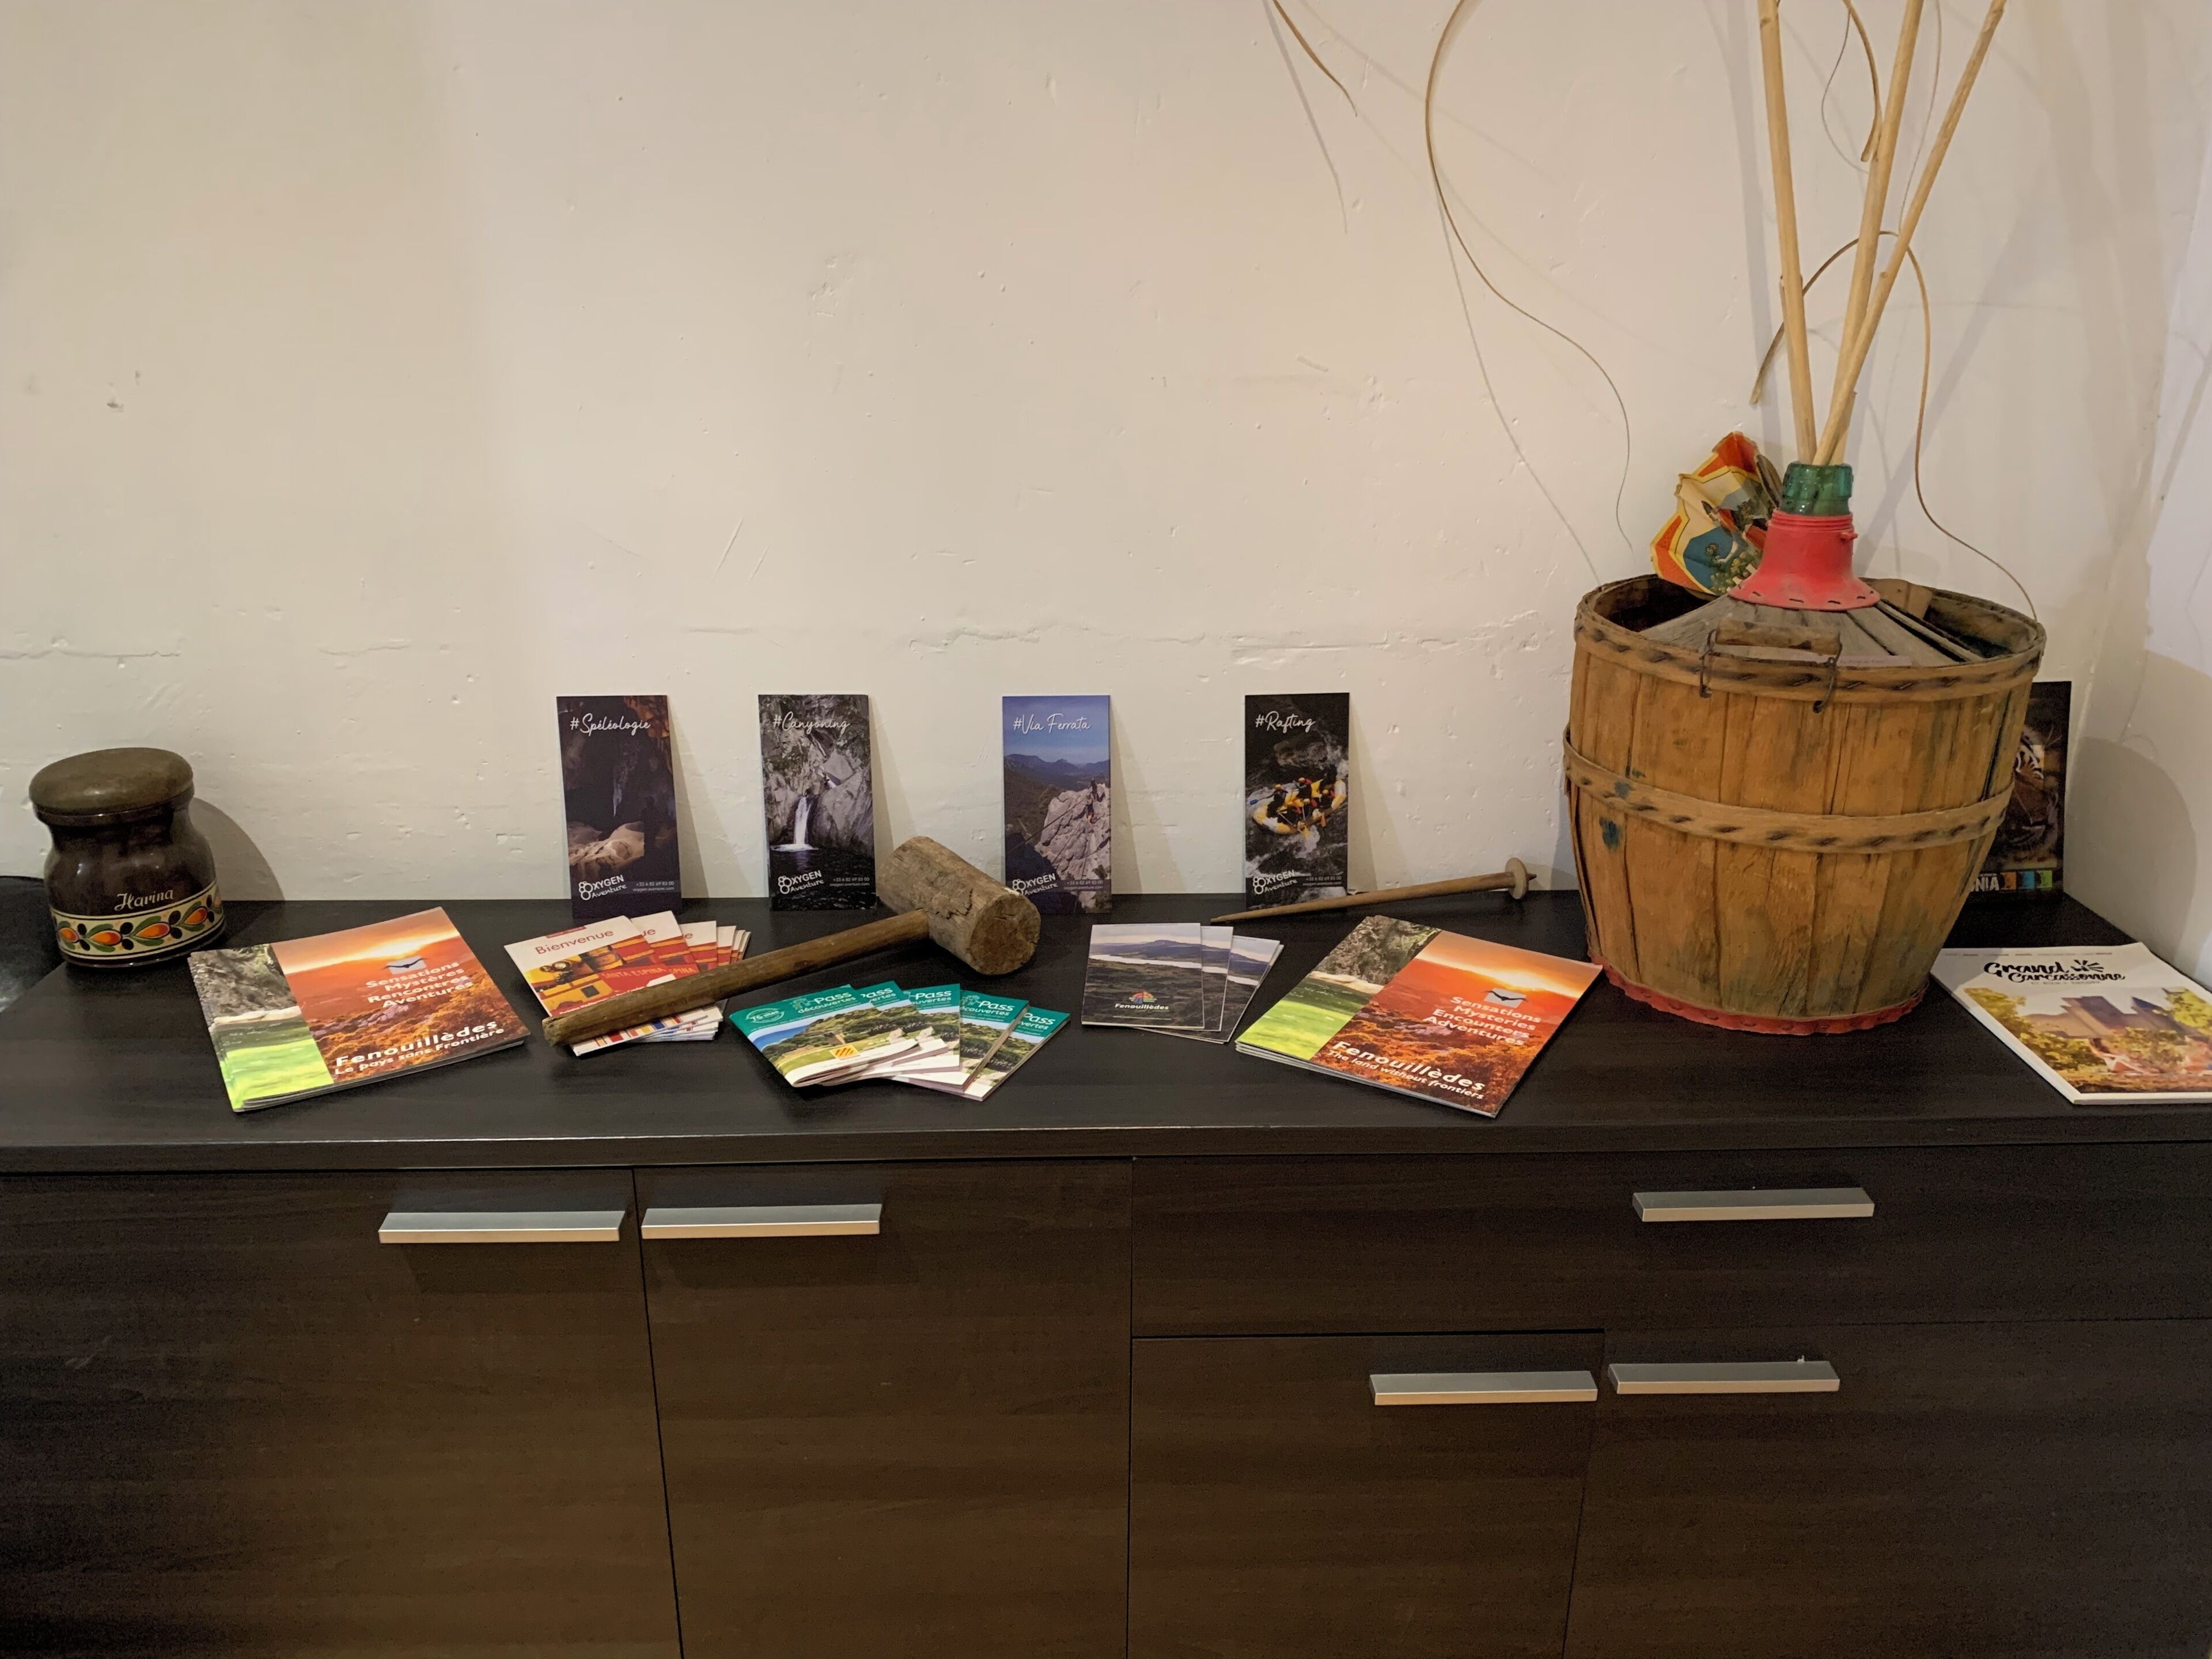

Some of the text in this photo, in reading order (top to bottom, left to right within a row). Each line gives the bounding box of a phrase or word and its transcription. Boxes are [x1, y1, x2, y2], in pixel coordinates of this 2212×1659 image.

[570, 713, 651, 737] #Spéléologie
[772, 711, 851, 734] #Canyoning
[1013, 713, 1093, 734] #Via Ferrata
[1255, 710, 1316, 733] #Rafting
[592, 884, 627, 899] Aventure
[790, 879, 824, 892] Aventure
[1024, 882, 1059, 896] Aventure
[1264, 879, 1297, 892] Aventure
[1971, 876, 1999, 892] NIA
[114, 889, 174, 911] Harina
[535, 930, 615, 955] Bienvenue
[366, 961, 460, 988] Sensations
[384, 968, 464, 991] Mystères
[631, 967, 666, 976] ESPINA
[1983, 961, 2070, 978] Grand
[2008, 972, 2126, 983] Carcassonne
[367, 975, 469, 1003] Rencontres
[382, 982, 474, 1008] Aventures
[814, 991, 853, 1004] Pass
[915, 990, 952, 1000] Pass
[798, 996, 857, 1014] découvertes
[978, 1001, 1015, 1012] Pass
[1450, 997, 1541, 1023] Sensations
[1432, 1009, 1530, 1039] Encounters
[1453, 1005, 1536, 1031] Mysteries
[1422, 1016, 1525, 1046] Adventures
[334, 1028, 505, 1075] Le pays sans Frontière
[335, 1021, 498, 1067] Fenouillèdes
[1327, 1050, 1484, 1100] The land without frontiers
[1332, 1041, 1486, 1091] Fenouillèdes
